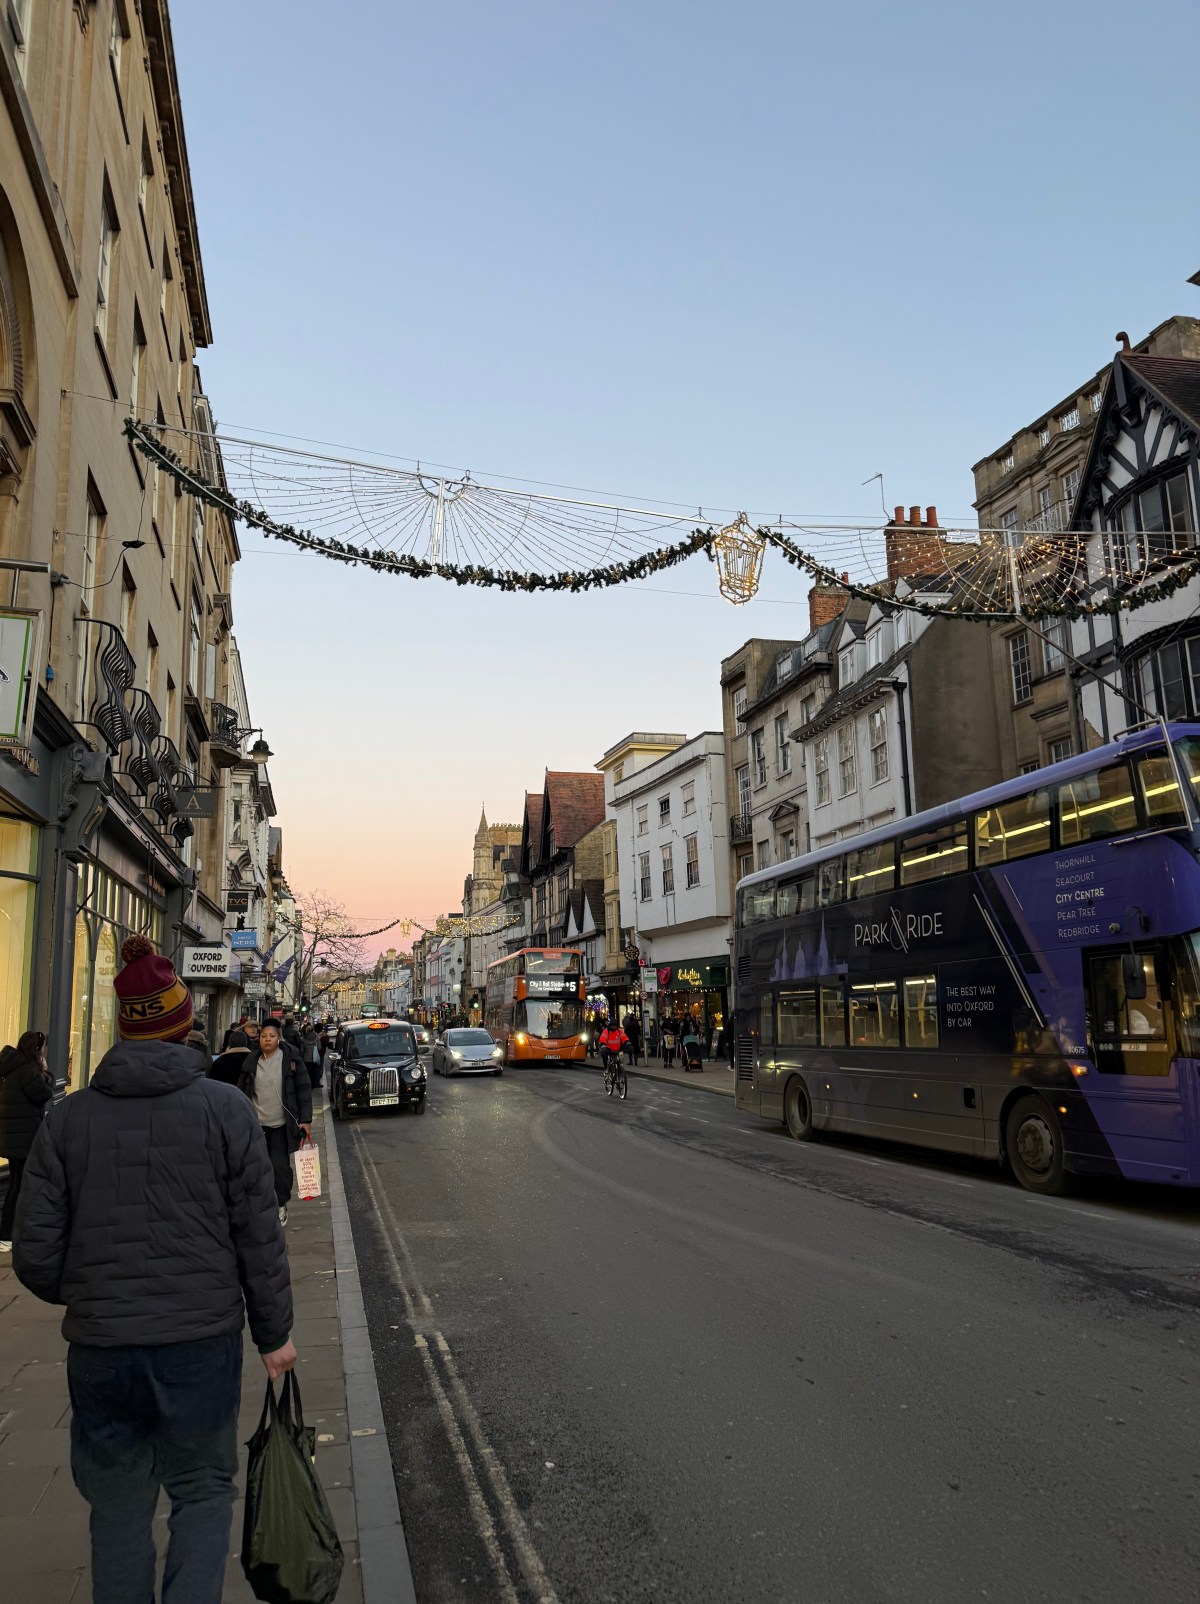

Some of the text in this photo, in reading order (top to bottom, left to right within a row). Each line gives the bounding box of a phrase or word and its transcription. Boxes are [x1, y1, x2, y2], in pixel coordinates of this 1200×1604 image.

[185, 794, 202, 809] A
[1054, 854, 1096, 870] THORNHILL
[1055, 872, 1095, 887] SEACOURT
[1055, 887, 1105, 904] CITY CENTRE
[1057, 907, 1097, 921] PEAR TREE
[854, 922, 890, 947] PARK
[906, 912, 944, 939] RIDE
[1058, 924, 1101, 938] REDBRIDGE
[192, 952, 223, 962] OXFORD
[187, 963, 228, 973] SOUVENIRS
[569, 981, 577, 992] 5
[945, 985, 996, 997] THE BEST WAY
[946, 1000, 995, 1012] INTO OXFORD
[947, 1017, 972, 1028] BY CAR
